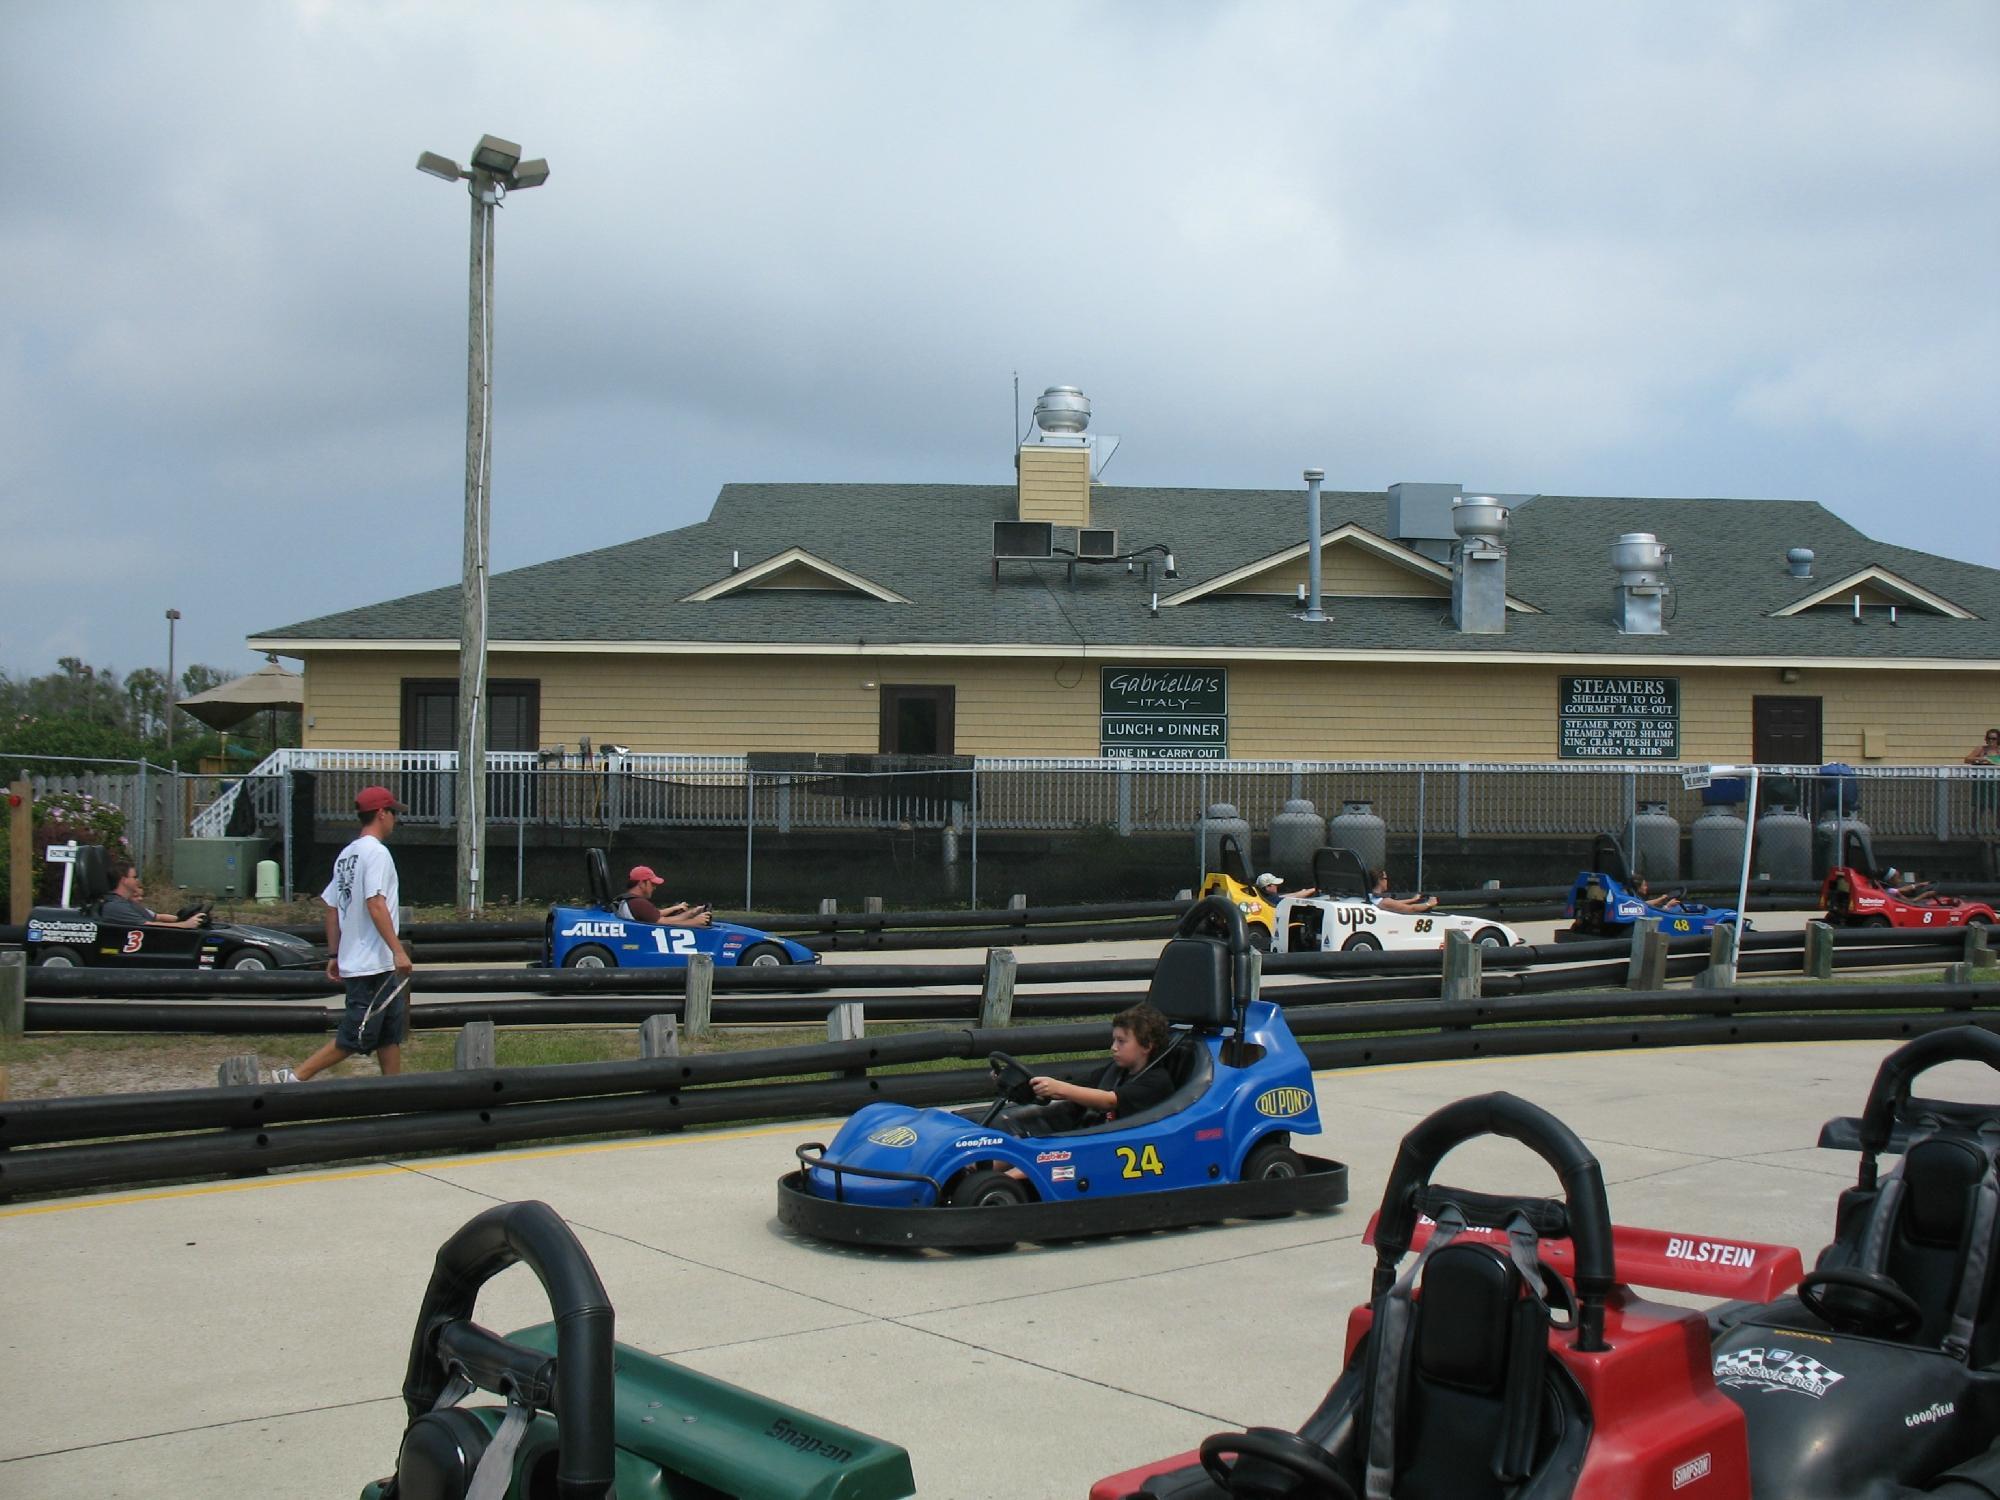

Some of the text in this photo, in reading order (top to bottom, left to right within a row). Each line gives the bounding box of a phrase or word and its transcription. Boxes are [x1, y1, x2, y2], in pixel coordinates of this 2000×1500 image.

[1109, 672, 1219, 696] Gabriella's
[1573, 679, 1665, 694] STEAMERS
[1572, 694, 1666, 704] SHELLFISH TO GO
[1565, 704, 1673, 714] GOURMET TAKE-OUT
[1108, 723, 1220, 736] LUNCH DINNER
[1565, 720, 1609, 729] STEAMER
[1613, 721, 1637, 729] POTS
[1641, 721, 1654, 729] TO
[1564, 729, 1673, 738] STEAMED SPICED SHRIMP
[1564, 738, 1674, 747] KING CRAB FRESH FISH
[1107, 749, 1220, 758] DINE IN CARRY OUT
[1576, 747, 1662, 756] CHICKEN & RIBS
[1922, 911, 1934, 924] 8
[29, 919, 98, 931] Goodwrench
[561, 922, 627, 937] ALLTEL
[1414, 918, 1434, 933] 88
[1673, 919, 1691, 932] 48
[122, 930, 144, 953] 3
[651, 927, 698, 954] 12
[1115, 1143, 1164, 1179] 24
[1665, 1238, 1756, 1268] BILSTEIN
[1904, 1402, 1955, 1427] GOODYEAR
[764, 1417, 852, 1463] Snap-on
[1675, 1456, 1708, 1485] SIMPSON
